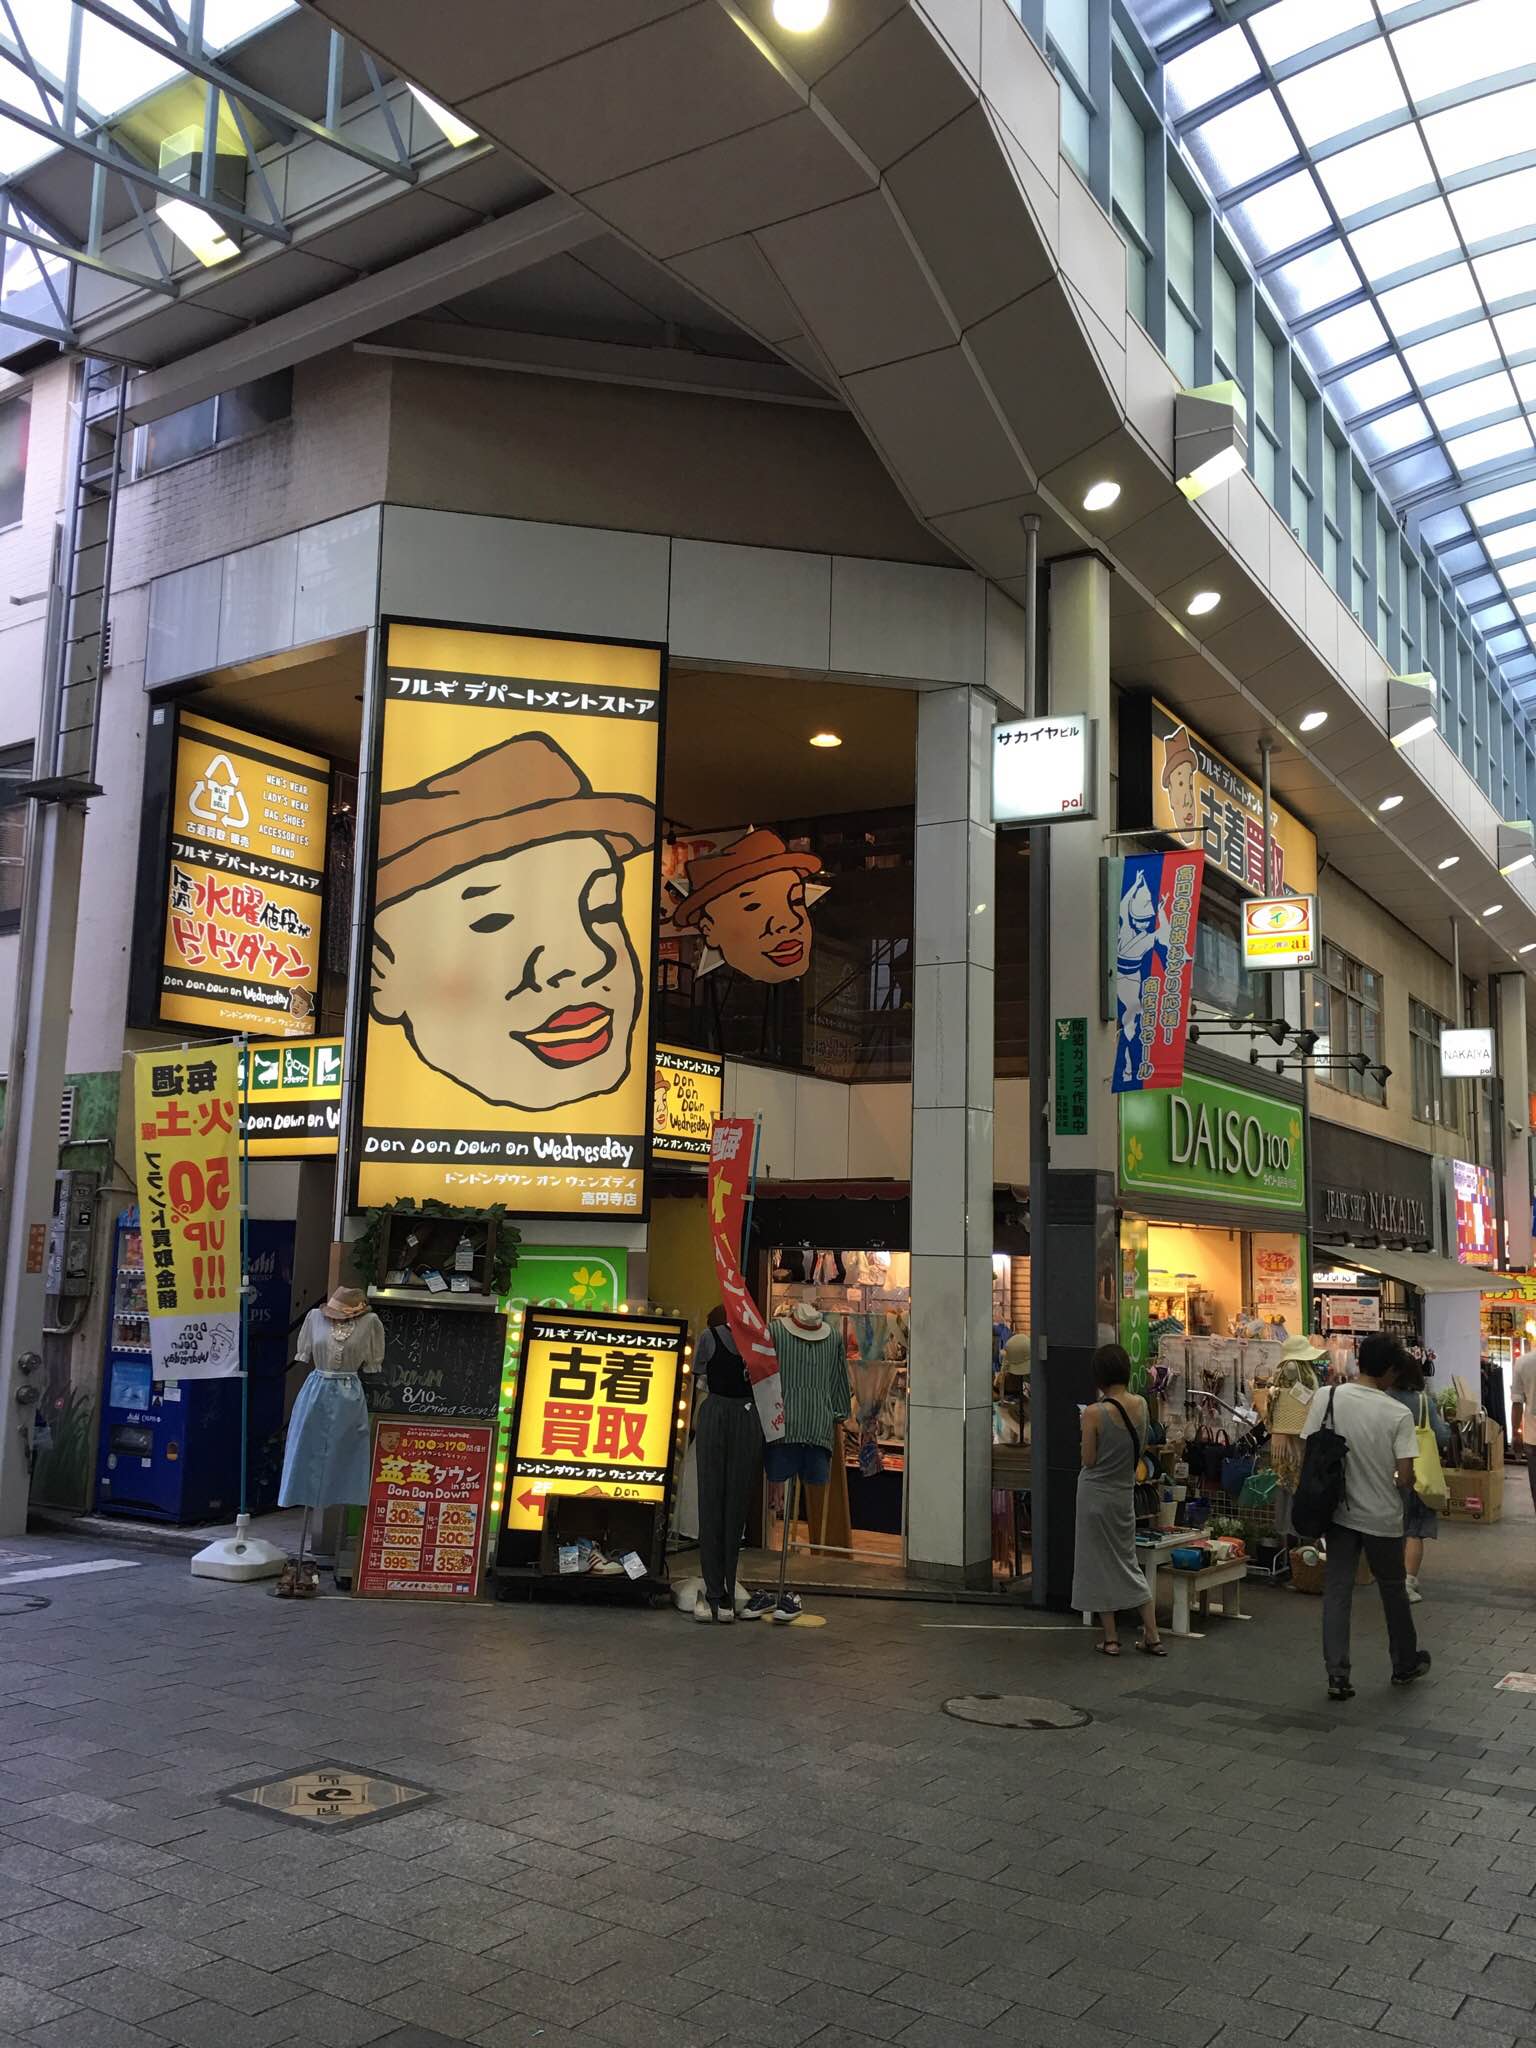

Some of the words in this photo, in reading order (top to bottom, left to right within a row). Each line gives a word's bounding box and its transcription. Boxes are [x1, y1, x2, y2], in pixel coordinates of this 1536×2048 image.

[996, 726, 1079, 746] サカイヤビル
[1061, 793, 1084, 812] pal
[282, 814, 306, 828] SHOES
[258, 824, 309, 846] ACCESSORIES
[271, 845, 295, 859] BRAND
[1298, 951, 1314, 963] pal
[164, 976, 184, 986] Don
[186, 980, 206, 991] Don
[207, 982, 229, 994] Down
[230, 987, 243, 997] on
[243, 985, 290, 1010] Wednesday
[674, 1073, 694, 1087] Don
[678, 1086, 698, 1100] Don
[682, 1100, 705, 1112] Down
[247, 1116, 273, 1130] Don
[273, 1114, 305, 1130] Down
[307, 1114, 324, 1128] on
[670, 1113, 710, 1138] Wednesday
[1169, 1095, 1264, 1178] DAISO
[1265, 1132, 1291, 1170] 100
[364, 1137, 405, 1153] Don
[411, 1138, 451, 1154] Don
[454, 1139, 501, 1156] Down
[505, 1142, 529, 1157] on
[533, 1134, 634, 1168] Wednesday
[581, 1192, 637, 1206] 高円寺店
[1325, 1190, 1348, 1222] JEANS
[1369, 1192, 1427, 1236] NAKAIYA
[548, 1347, 656, 1406] 古着
[408, 1403, 457, 1415] Coming
[541, 1400, 649, 1462] 買取
[387, 1484, 410, 1497] Bon
[411, 1487, 434, 1498] Bon
[435, 1488, 470, 1499] Down
[460, 1482, 480, 1490] 2016
[614, 1486, 640, 1497] Don
